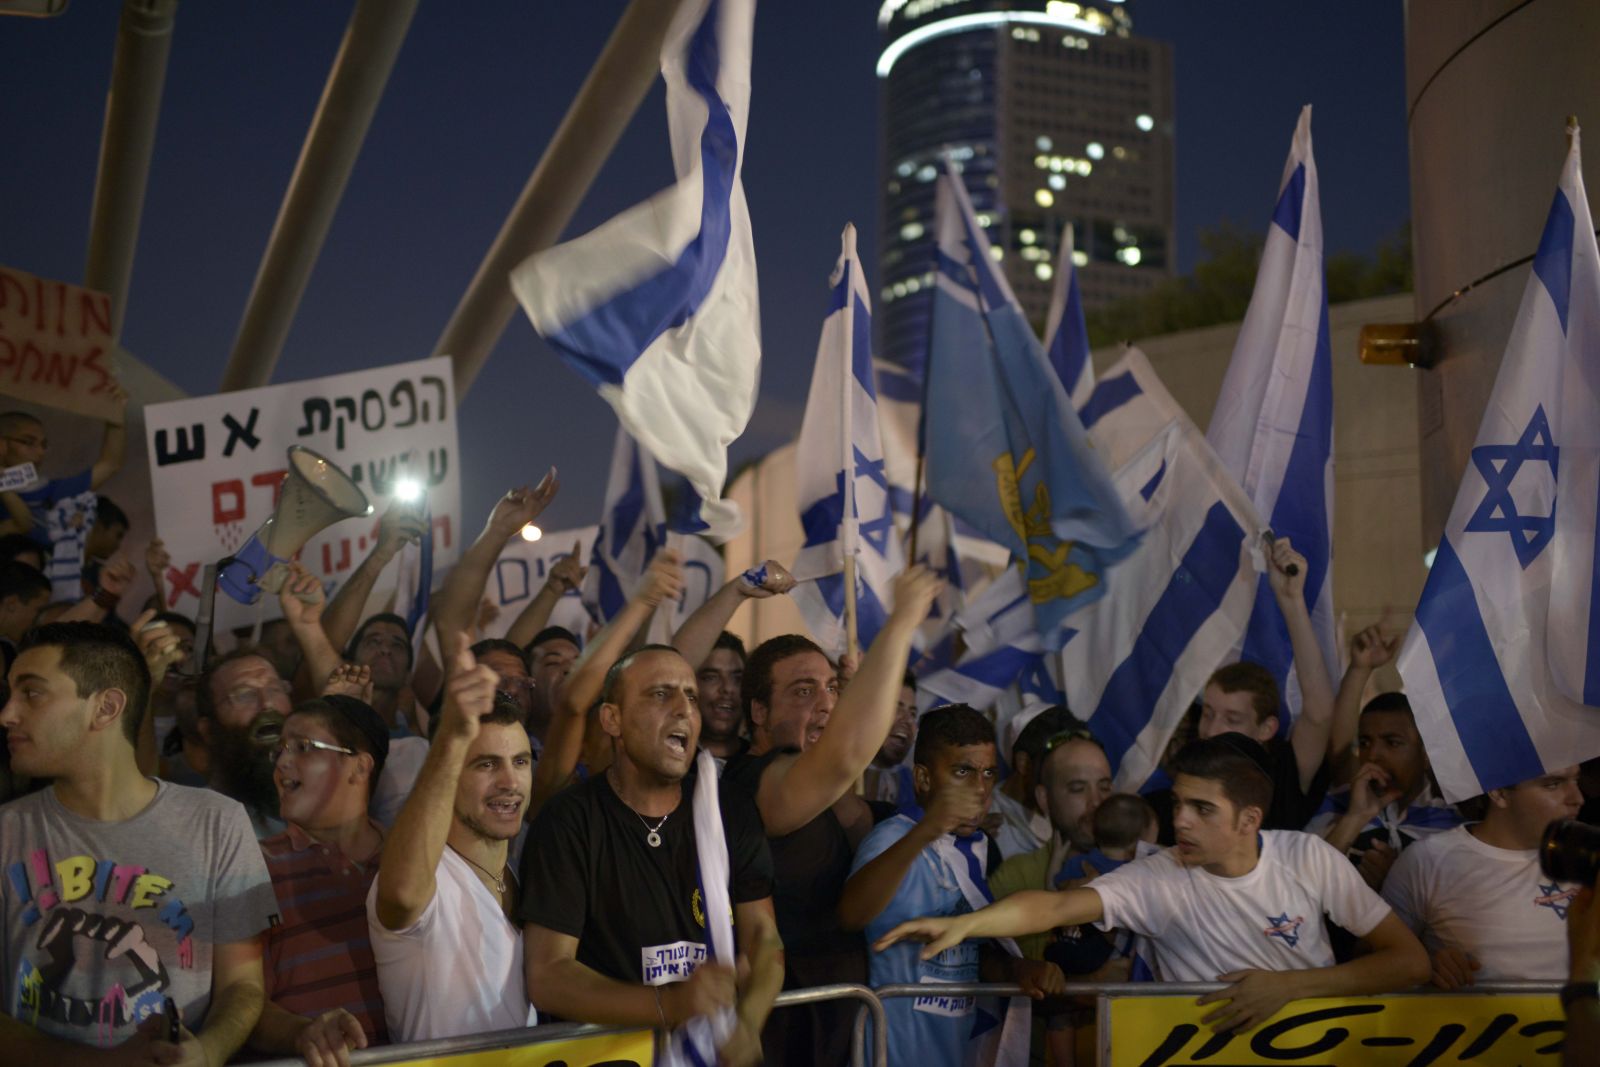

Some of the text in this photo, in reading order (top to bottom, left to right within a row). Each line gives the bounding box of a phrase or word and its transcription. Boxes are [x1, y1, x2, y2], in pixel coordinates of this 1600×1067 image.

[155, 376, 447, 467] הפסקת אש
[646, 963, 679, 981] איתן
